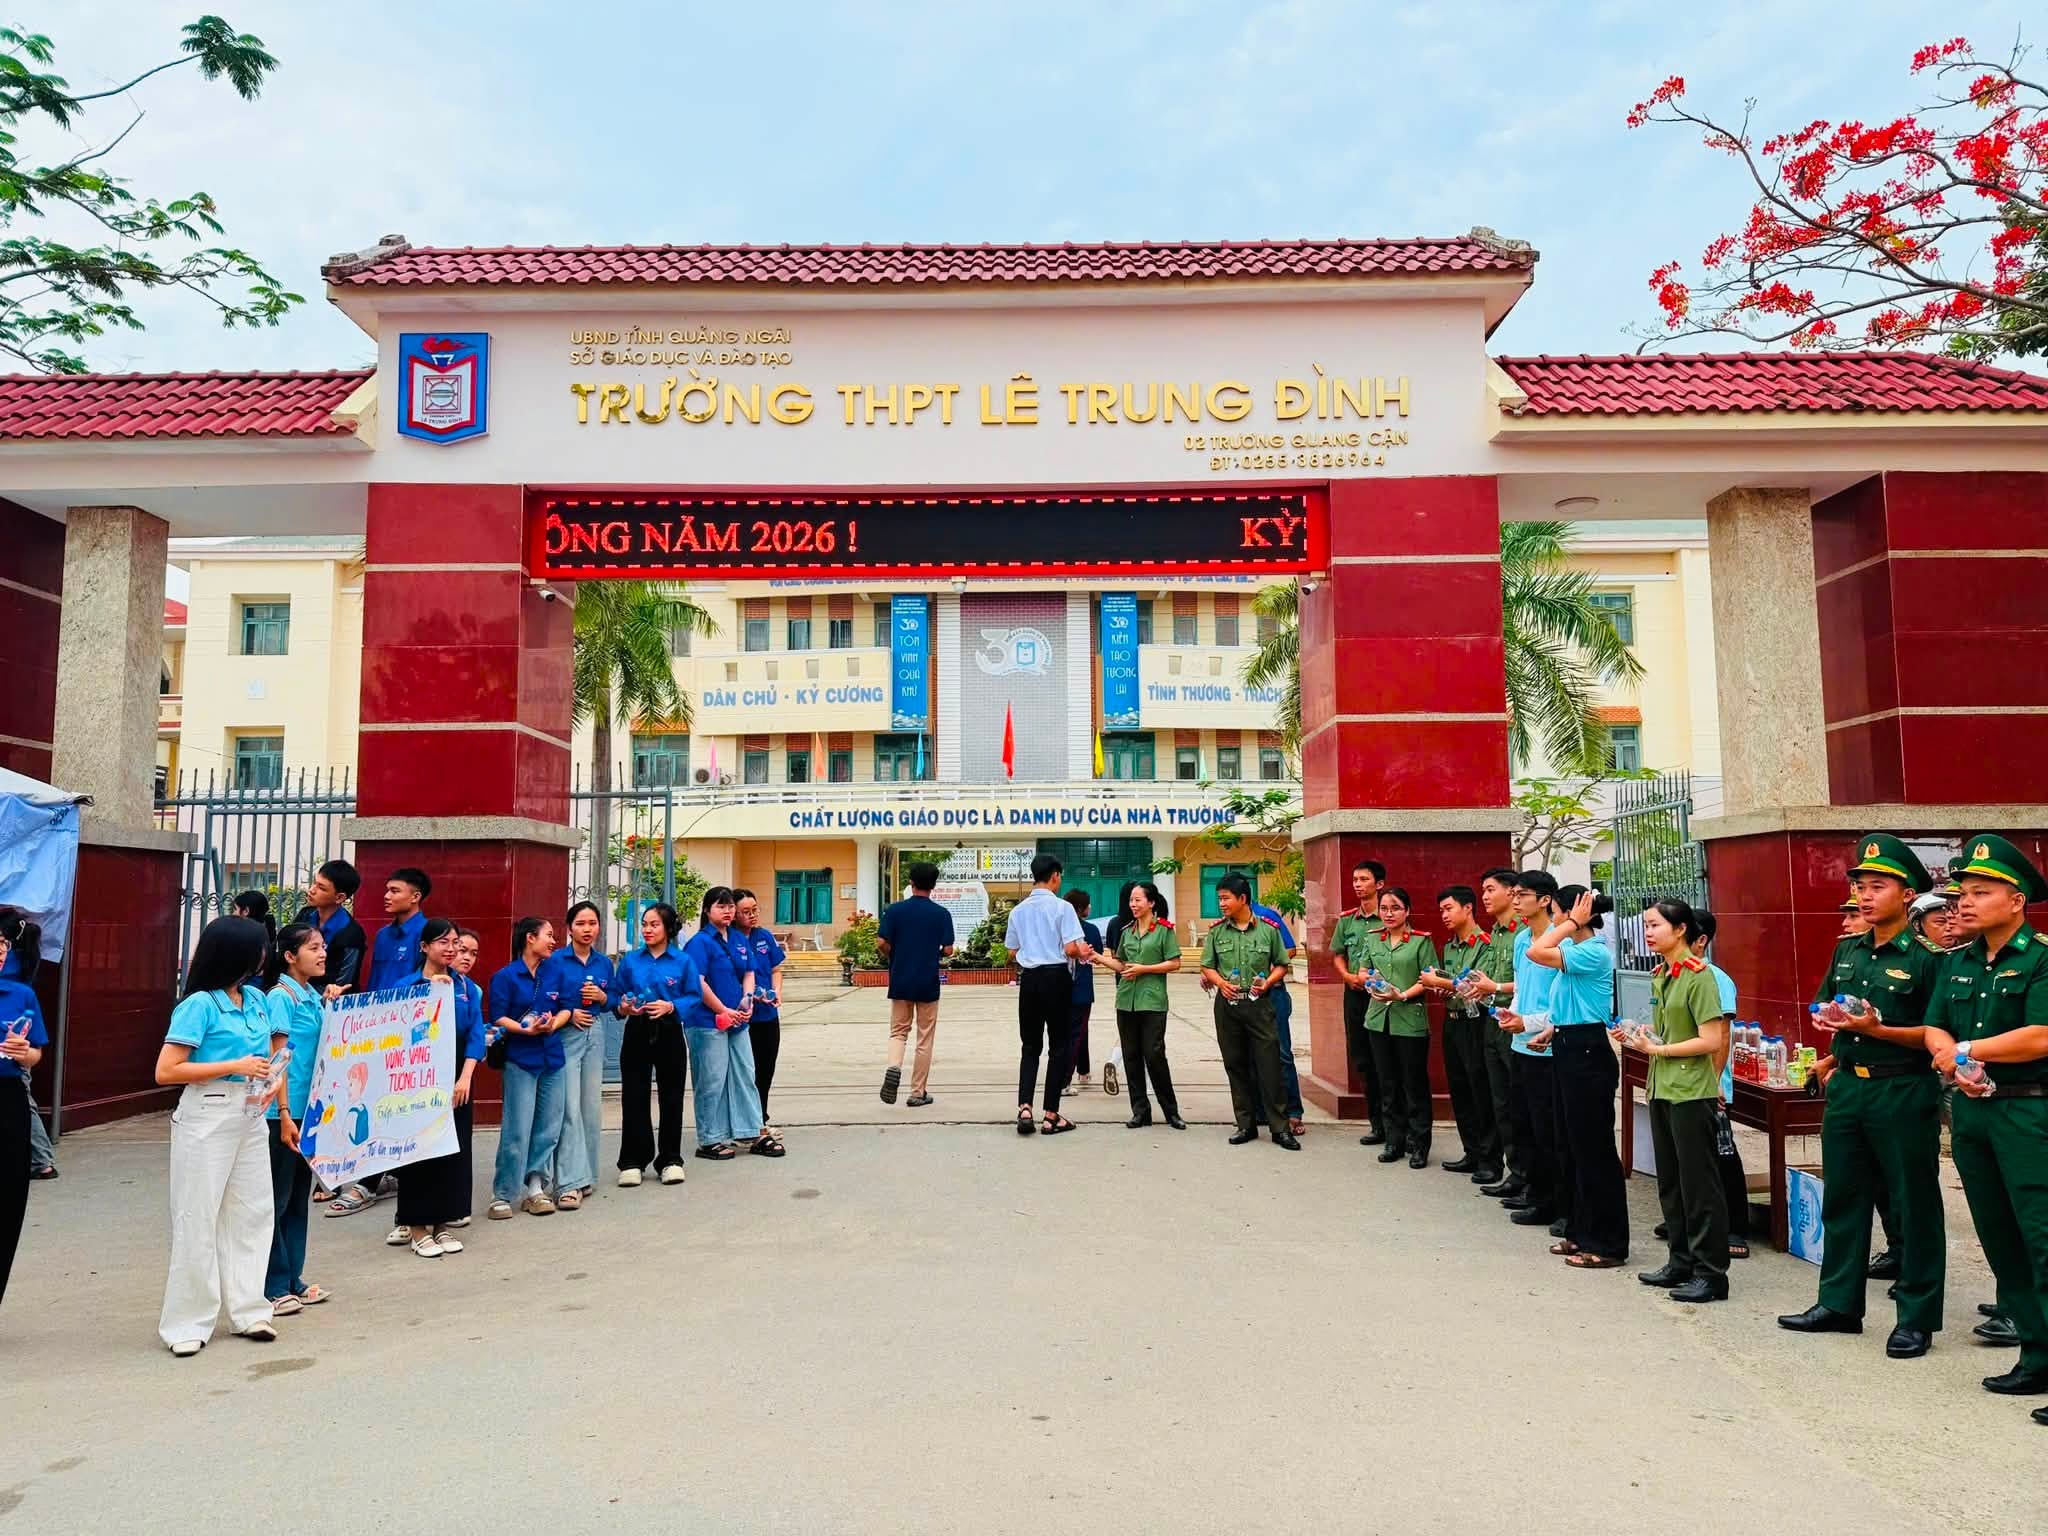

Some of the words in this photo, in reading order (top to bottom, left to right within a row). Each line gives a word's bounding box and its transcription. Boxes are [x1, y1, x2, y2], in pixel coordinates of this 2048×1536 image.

[570, 330, 620, 344] UBND
[624, 325, 664, 344] TỈNH
[668, 325, 740, 344] QUẢNG
[744, 328, 792, 344] NGÃI
[600, 348, 647, 365] GIÁO
[650, 351, 689, 369] DỤC
[692, 349, 716, 365] VÀ
[719, 348, 757, 366] ĐÀO
[760, 351, 793, 370] TẠO
[571, 368, 815, 424] TRƯỜNG
[837, 383, 960, 425] THPT
[980, 370, 1040, 425] LÊ
[1059, 380, 1253, 424] TRUNG
[1274, 361, 1409, 420] ĐÌNH
[1184, 434, 1206, 450] 02
[1291, 431, 1361, 449] QUANG
[640, 515, 742, 553] NĂM
[751, 520, 836, 553] 2026
[848, 521, 857, 552] !
[703, 688, 736, 707] DÂN
[743, 684, 777, 706] CHỦ
[826, 684, 884, 704] CƯƠNG
[1147, 682, 1177, 701] TÌNH
[1181, 683, 1231, 702] THƯƠNG
[790, 805, 834, 828] CHẤT
[838, 809, 895, 830] LƯỢNG
[899, 807, 939, 827] GIÁO
[943, 809, 979, 829] DỤC
[983, 806, 1005, 826] LÀ
[1010, 808, 1056, 825] DANH
[1061, 806, 1084, 828] DỰ
[1088, 804, 1122, 825] CỦA
[1127, 805, 1162, 825] NHÀ
[1167, 805, 1236, 825] TRƯỜNG
